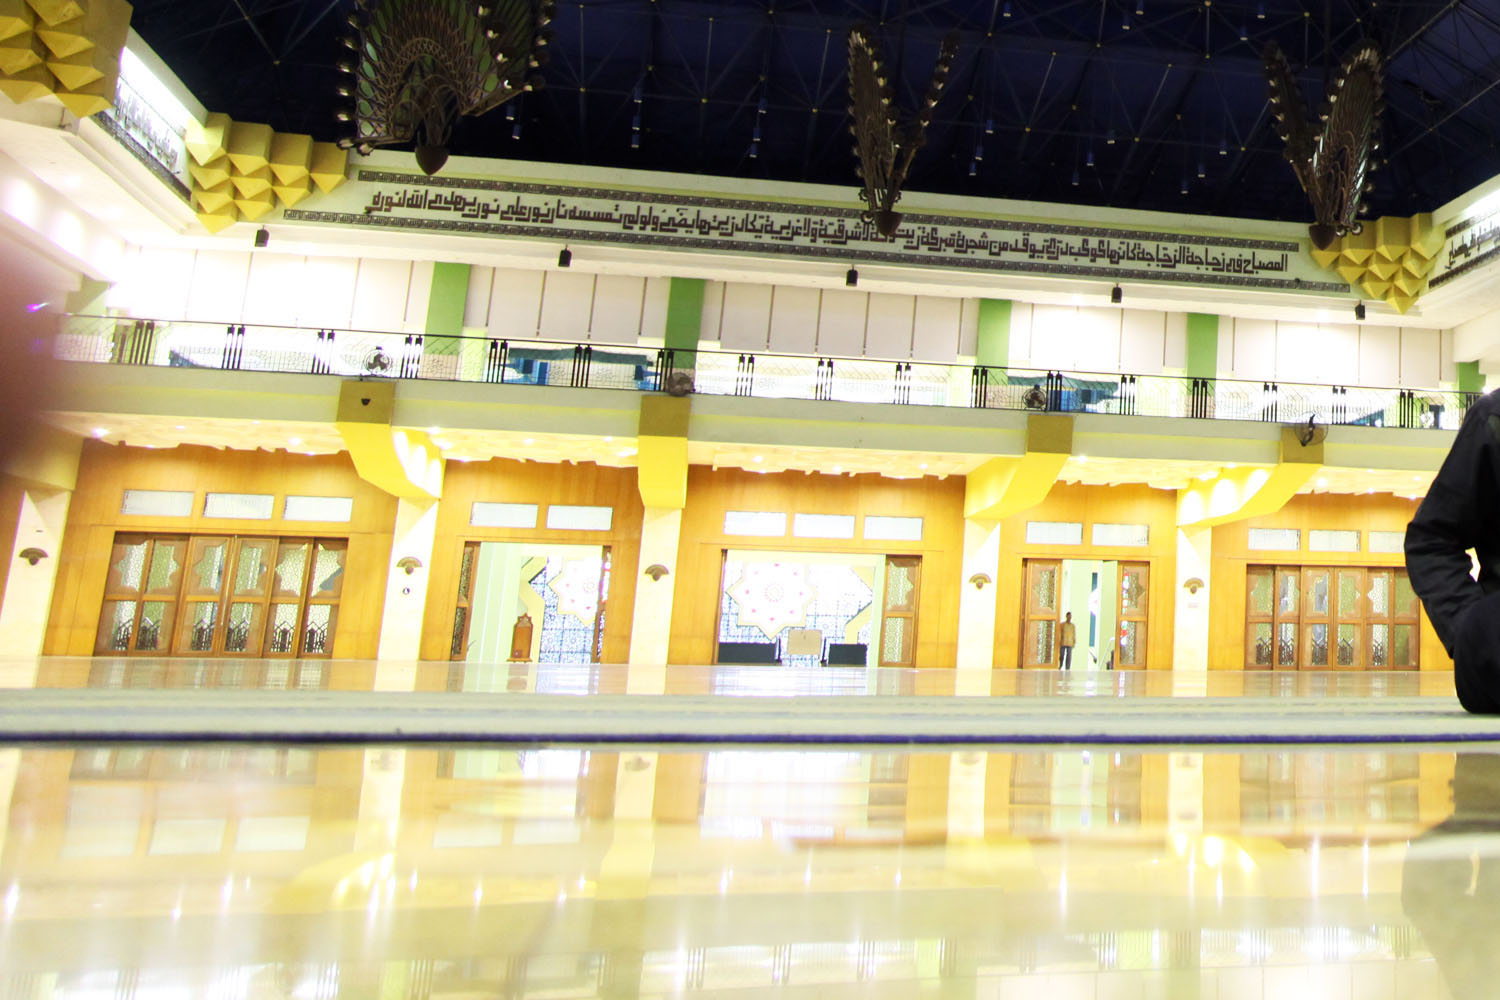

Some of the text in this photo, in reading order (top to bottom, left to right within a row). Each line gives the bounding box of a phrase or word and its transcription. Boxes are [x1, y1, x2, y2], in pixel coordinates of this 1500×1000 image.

[406, 189, 429, 209] الله
[989, 240, 1009, 256] من
[1069, 238, 1106, 262] كوكب
